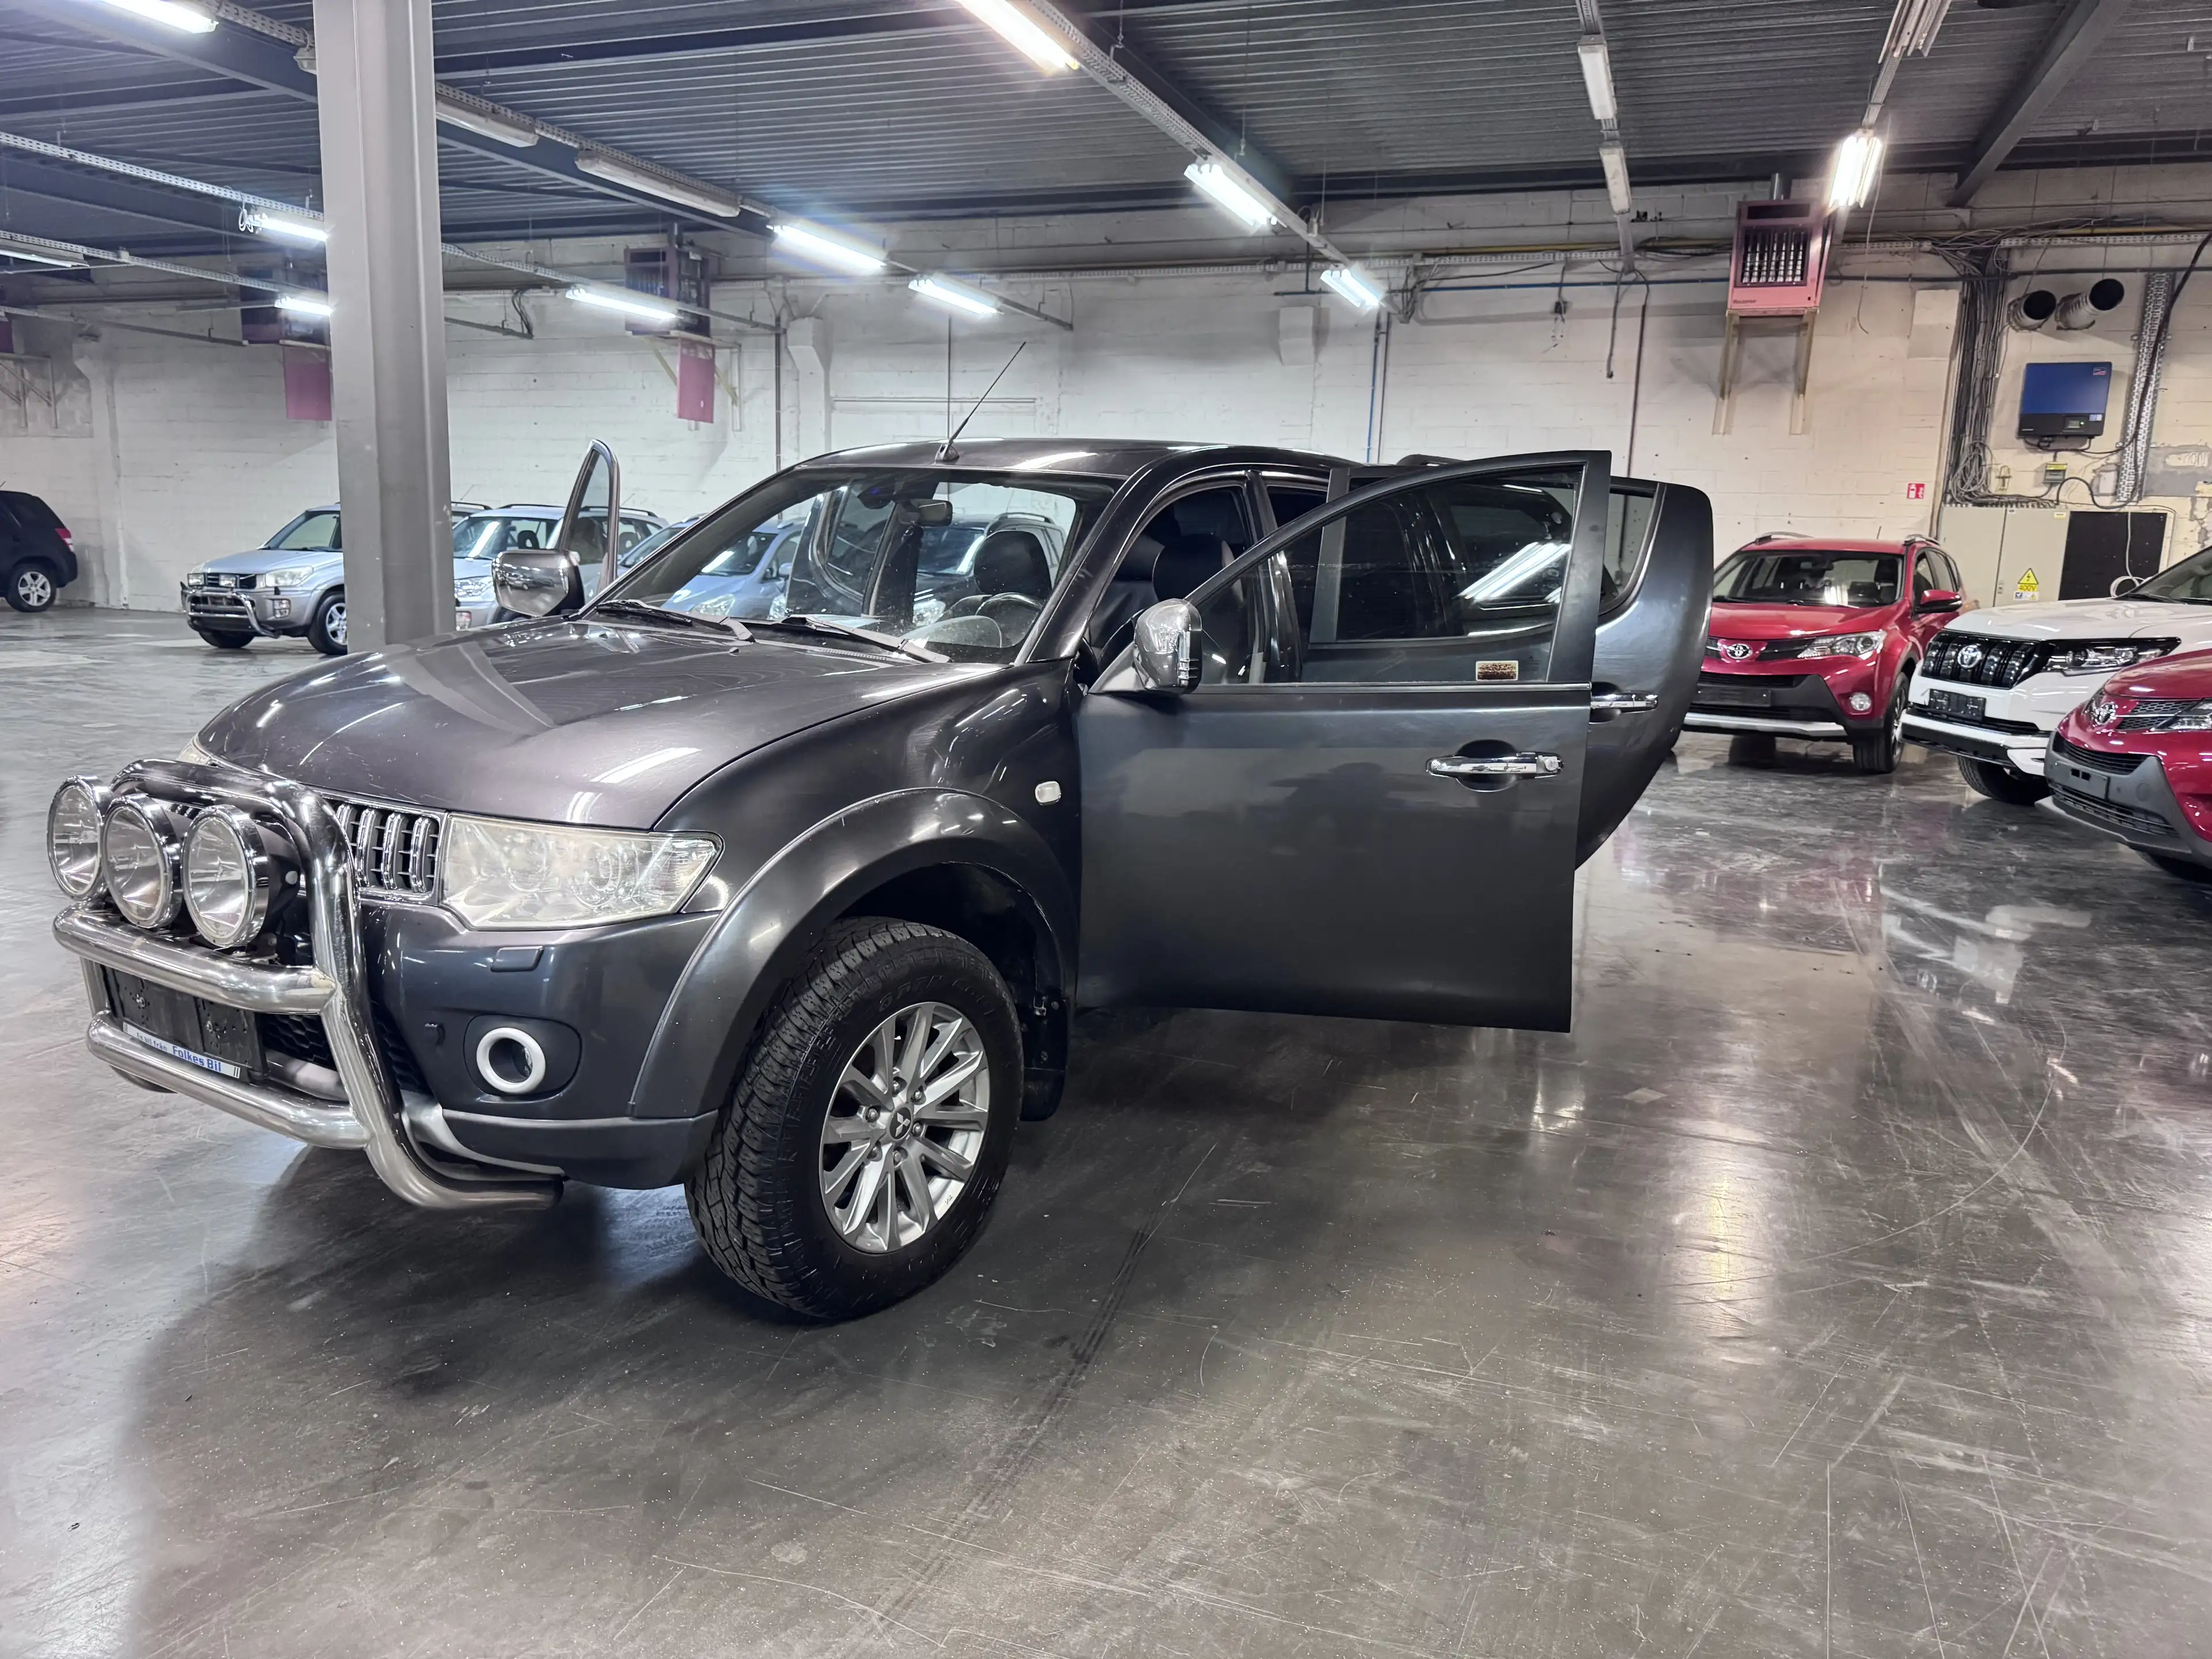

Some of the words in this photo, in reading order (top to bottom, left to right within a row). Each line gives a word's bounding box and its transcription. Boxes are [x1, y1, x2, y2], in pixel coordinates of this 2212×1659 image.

[153, 1040, 167, 1051] från
[172, 1046, 204, 1066] Folkes
[207, 1058, 221, 1071] Bil
